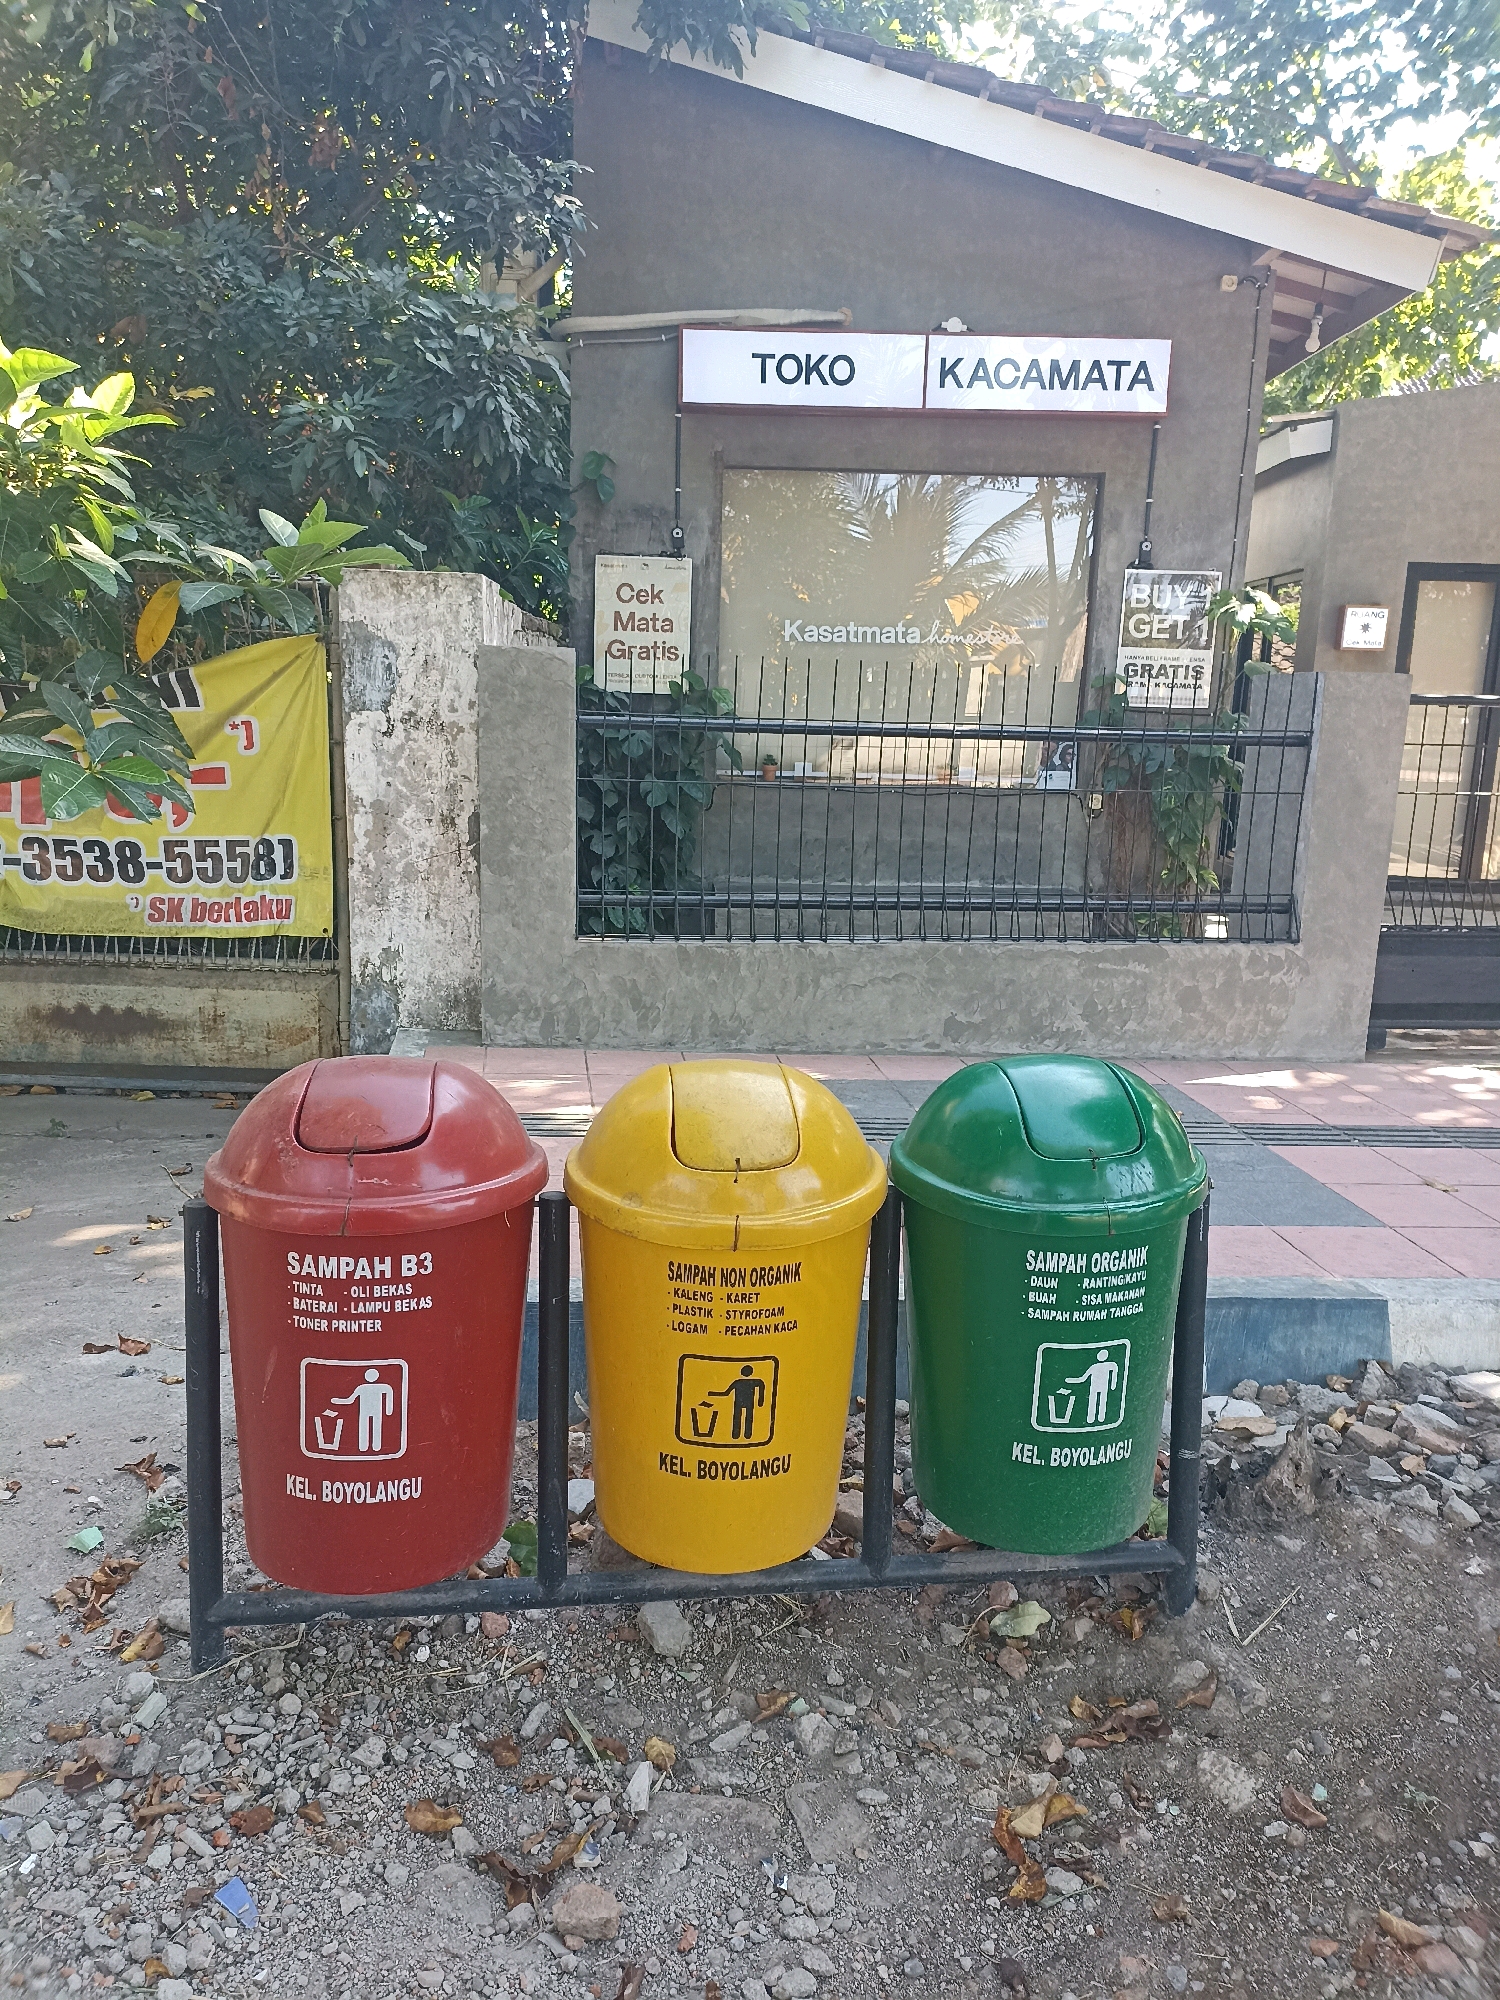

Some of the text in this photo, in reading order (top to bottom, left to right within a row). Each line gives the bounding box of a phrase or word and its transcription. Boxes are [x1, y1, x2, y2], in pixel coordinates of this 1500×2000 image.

[751, 352, 1155, 392] TOKO KACAMATA
[615, 582, 665, 605] Cek
[1130, 583, 1194, 609] BUY
[613, 610, 674, 633] Mata
[1350, 610, 1385, 619] RUANG
[783, 619, 1024, 645] Kasatmata homestore
[1128, 613, 1191, 640] GET
[606, 639, 680, 661] Gratis
[1123, 662, 1205, 681] GRATIS
[0, 836, 294, 884] -3538-5558)
[148, 896, 186, 923] SK
[190, 894, 292, 923] berlaku
[287, 1251, 433, 1280] SAMPAH B3
[1025, 1244, 1149, 1274] SAMPAH ORGANIK
[667, 1260, 803, 1288] SAMPAH NON ORGANIK
[1030, 1275, 1059, 1289] DAUN
[292, 1280, 324, 1297] TINTA
[350, 1282, 413, 1298] OLI BEKAS
[673, 1287, 714, 1303] KALENG
[726, 1292, 761, 1304] KARET
[1028, 1291, 1057, 1305] BUAH
[1081, 1286, 1146, 1306] SISA MAKANAN
[292, 1296, 338, 1314] BATERAI
[350, 1295, 433, 1314] LAMPU BEKAS
[672, 1302, 714, 1319] PLASTIK
[725, 1305, 785, 1321] STYROFOAM
[1027, 1302, 1144, 1322] SAMPAH RUMAH TANGGA
[292, 1315, 382, 1333] TONER PRINTER
[671, 1320, 708, 1335] LOGAM
[724, 1319, 798, 1336] PECAHAN KACA
[1011, 1438, 1133, 1468] KEL. BOYOLANGU
[659, 1451, 792, 1481] KEL. BOYOLANGU
[286, 1473, 423, 1504] KEL. BOYOLANGU
